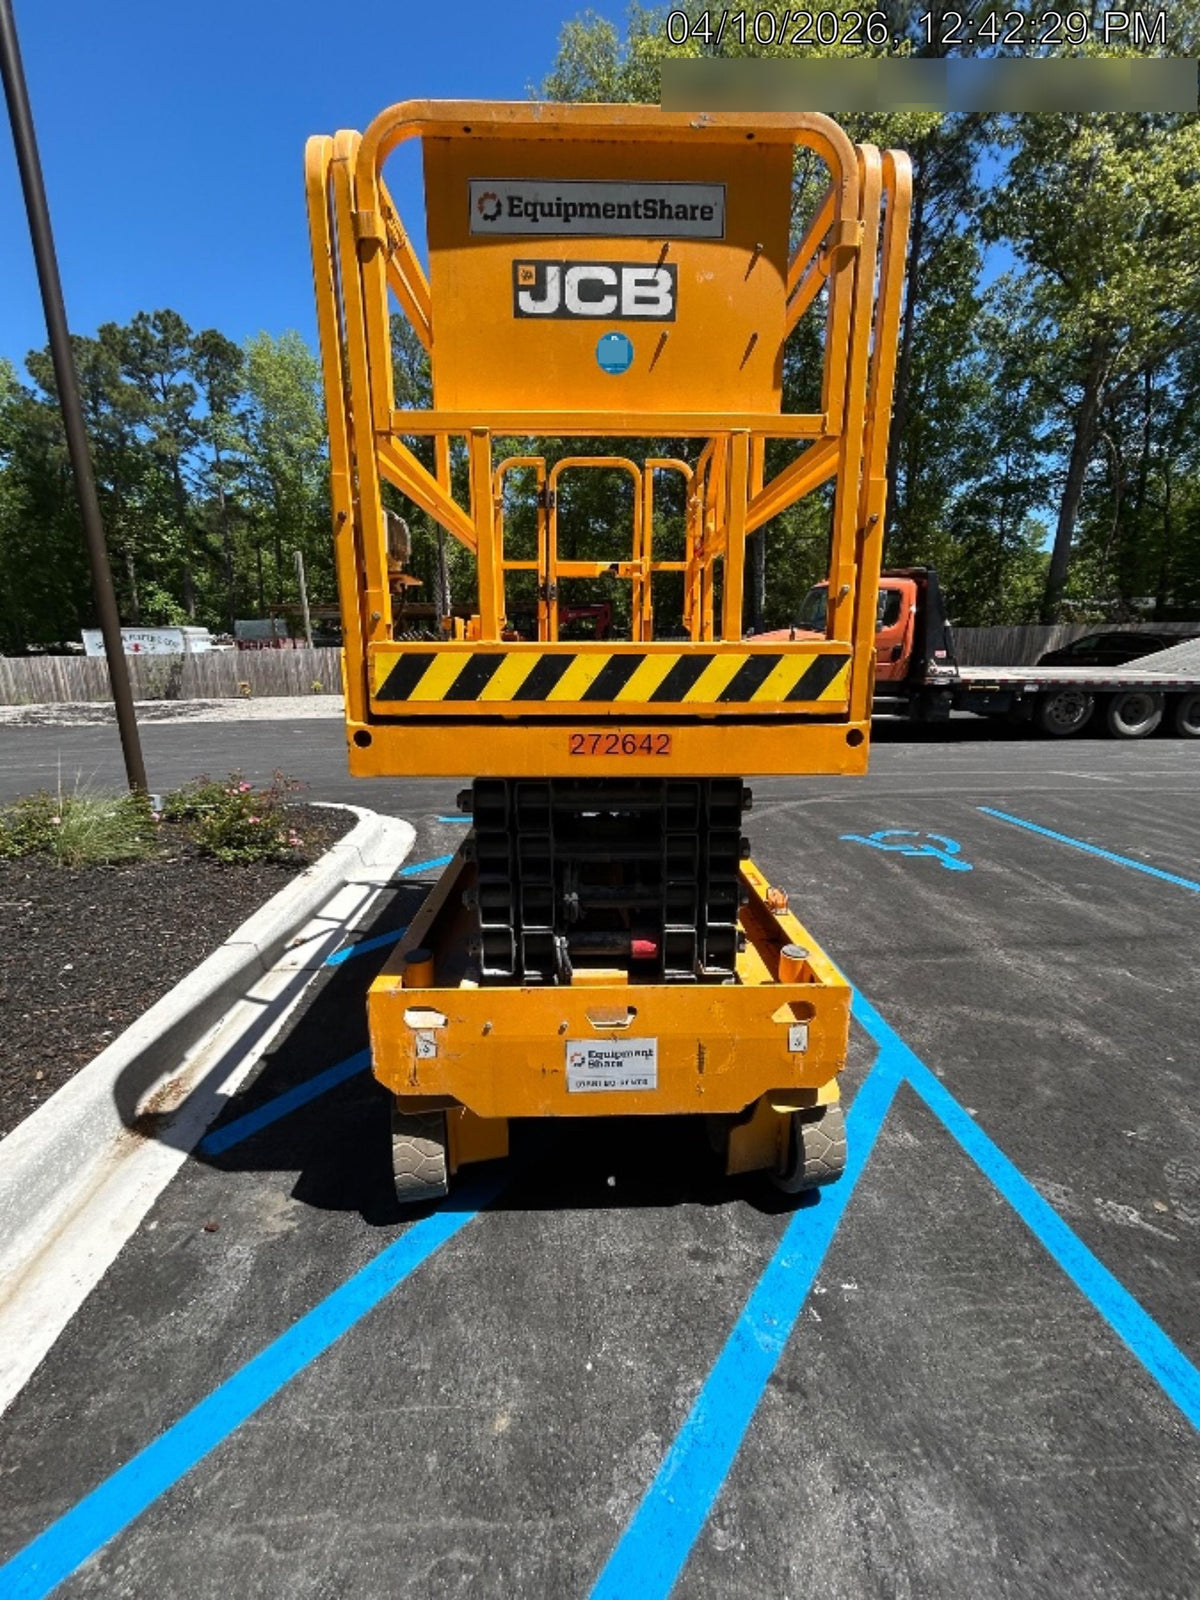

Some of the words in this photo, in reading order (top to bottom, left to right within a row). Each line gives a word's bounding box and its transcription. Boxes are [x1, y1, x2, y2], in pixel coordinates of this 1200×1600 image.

[507, 195, 714, 222] EquipmentShare
[518, 265, 674, 316] JCB
[570, 734, 671, 756] 272642
